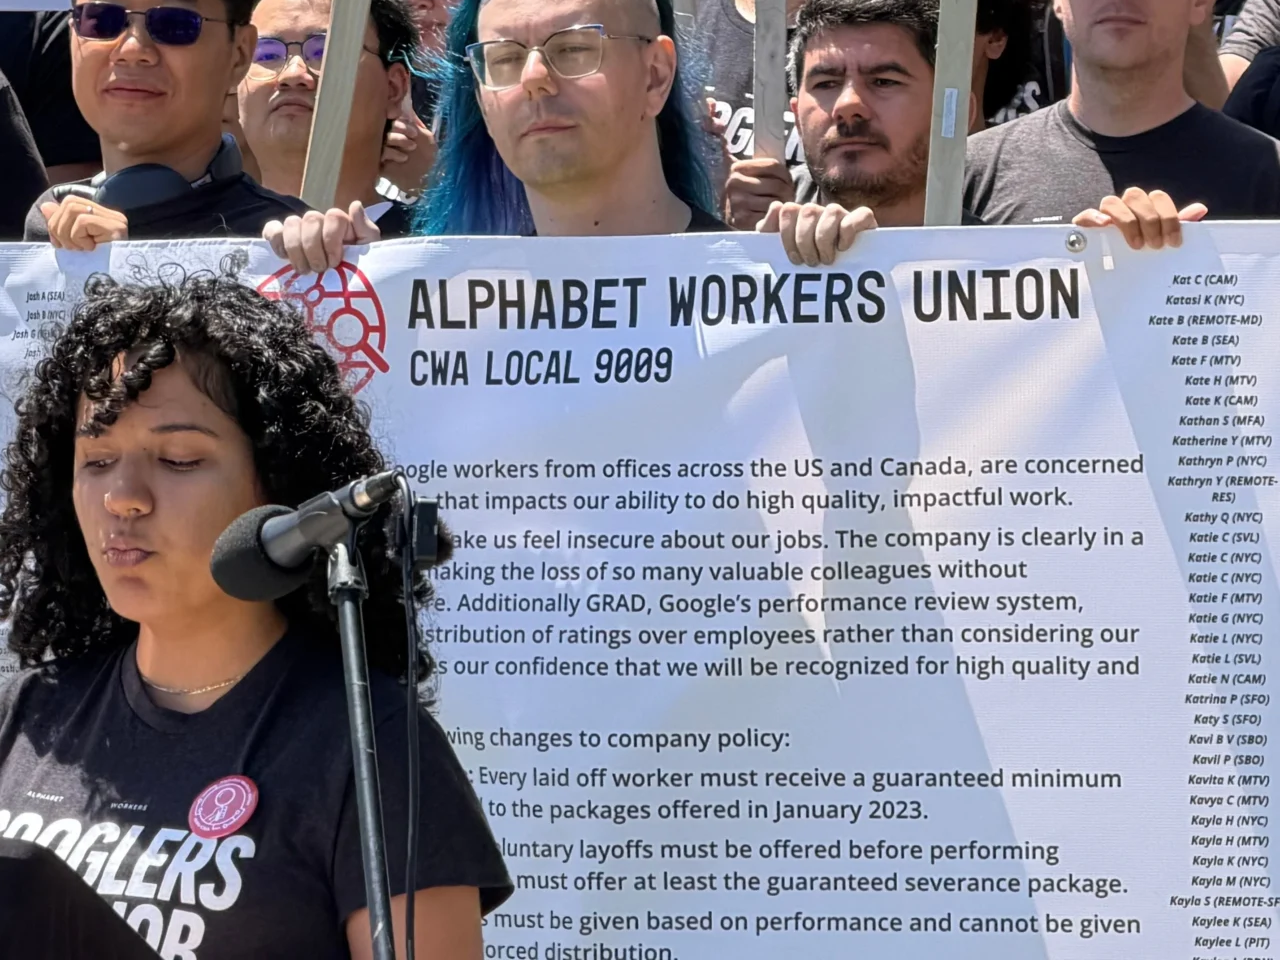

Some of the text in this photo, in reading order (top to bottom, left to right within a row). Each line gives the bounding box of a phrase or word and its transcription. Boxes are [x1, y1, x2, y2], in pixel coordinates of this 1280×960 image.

[1173, 275, 1237, 286] Kat C (CAM)
[408, 268, 1079, 329] ALPHABET WORKERS UNION
[1149, 315, 1262, 326] Kate B (REMOTE-MD)
[411, 347, 672, 386] CWA LOCAL 9009
[1173, 436, 1272, 447] Katherine Y (MTV)
[454, 459, 538, 478] workers
[545, 459, 595, 478] from
[603, 459, 671, 478] offices
[678, 463, 743, 477] across
[750, 458, 786, 477] the
[795, 459, 823, 477] US
[831, 457, 872, 477] and
[881, 456, 972, 477] Canada,
[981, 460, 1017, 474] are
[1025, 454, 1143, 473] concerned
[437, 491, 478, 510] that
[486, 491, 567, 515] impacts
[574, 496, 609, 509] our
[616, 491, 679, 514] ability
[685, 492, 705, 509] to
[713, 490, 739, 509] do
[747, 490, 794, 514] high
[802, 490, 885, 514] quality,
[894, 487, 1002, 512] impactful
[1010, 487, 1072, 506] work.
[457, 593, 580, 617] Additionally
[587, 594, 651, 615] GRAD,
[759, 593, 906, 618] performance
[915, 592, 989, 610] review
[997, 594, 1083, 616] system,
[479, 766, 1121, 792] Every laid off worker must receive a guaranteed minimum
[489, 799, 927, 824] to the packages offered in January 2023.
[517, 871, 1127, 898] must offer at least the guaranteed severance package.
[1192, 876, 1270, 889] Kayla M (NYC)
